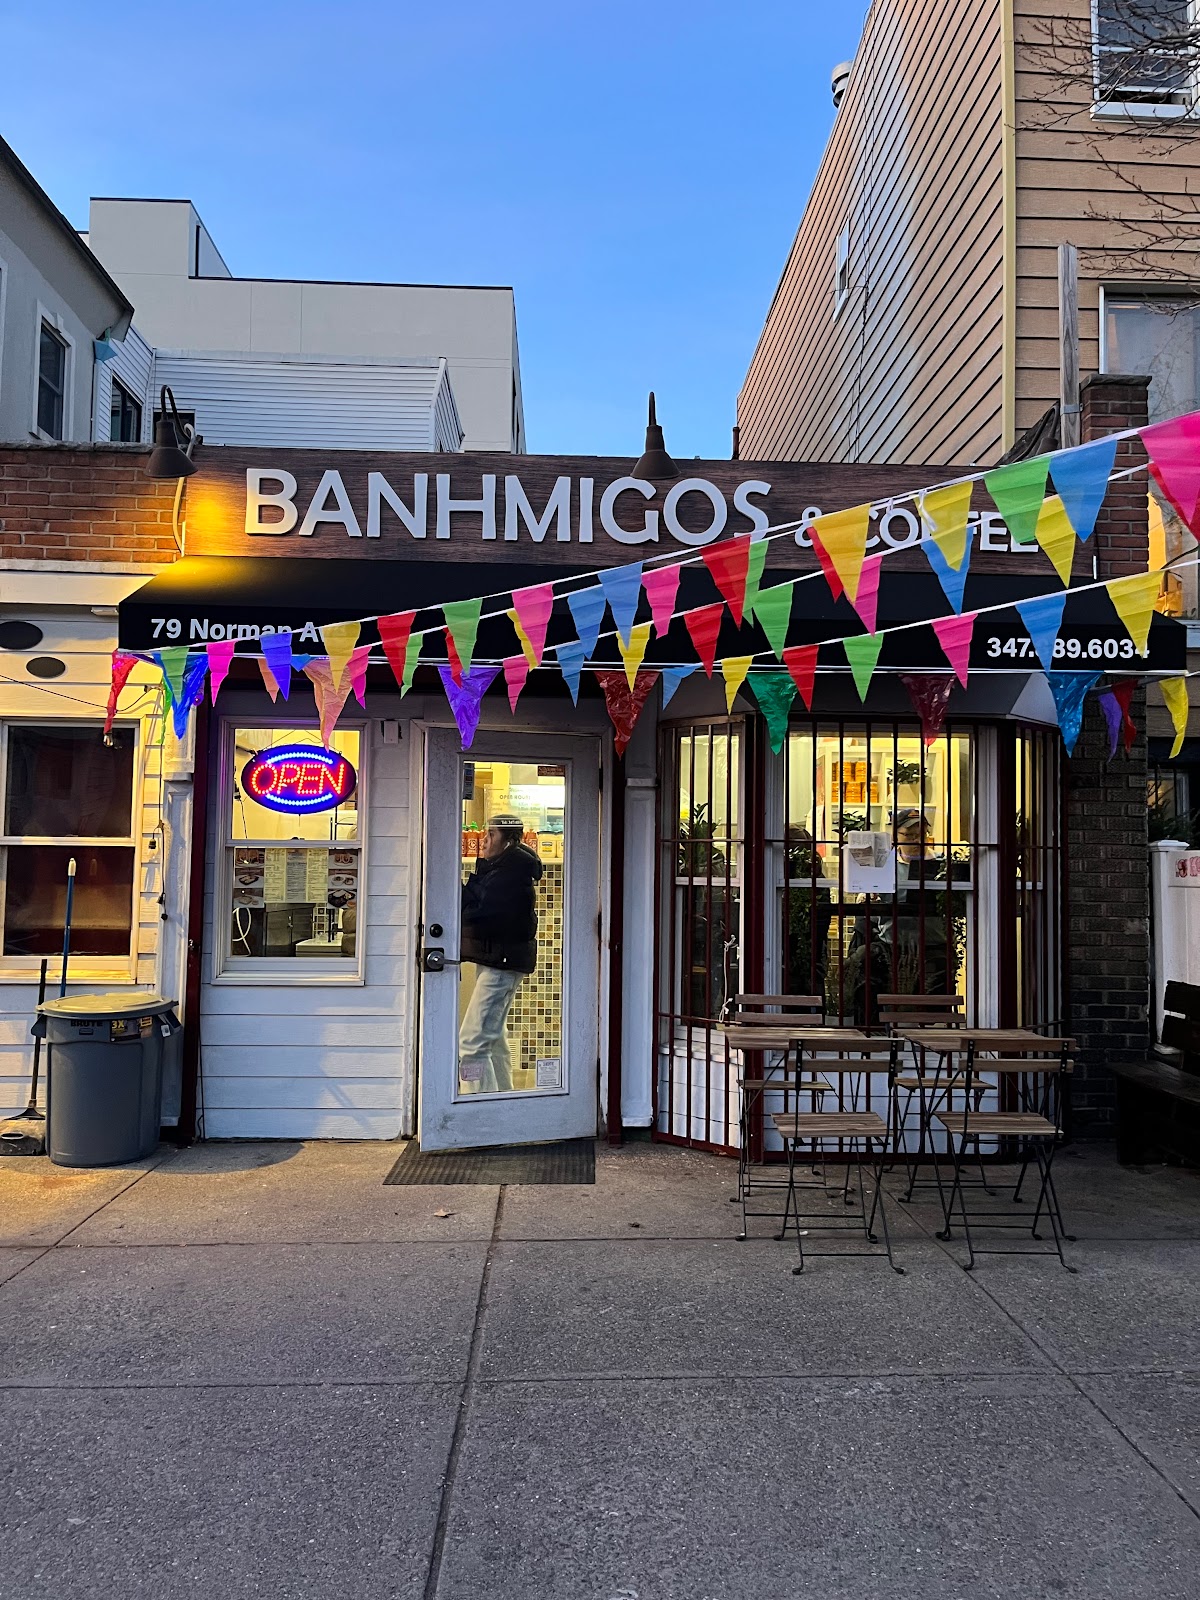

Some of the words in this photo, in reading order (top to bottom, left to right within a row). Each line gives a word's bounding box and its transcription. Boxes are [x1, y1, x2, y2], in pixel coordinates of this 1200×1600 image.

[245, 467, 771, 546] BANHMIGOS
[794, 506, 825, 548] &
[151, 618, 182, 639] 79
[189, 618, 292, 641] Norman
[986, 637, 1150, 659] 347.89.6034
[251, 763, 345, 795] OPEN
[111, 1019, 125, 1029] 3X
